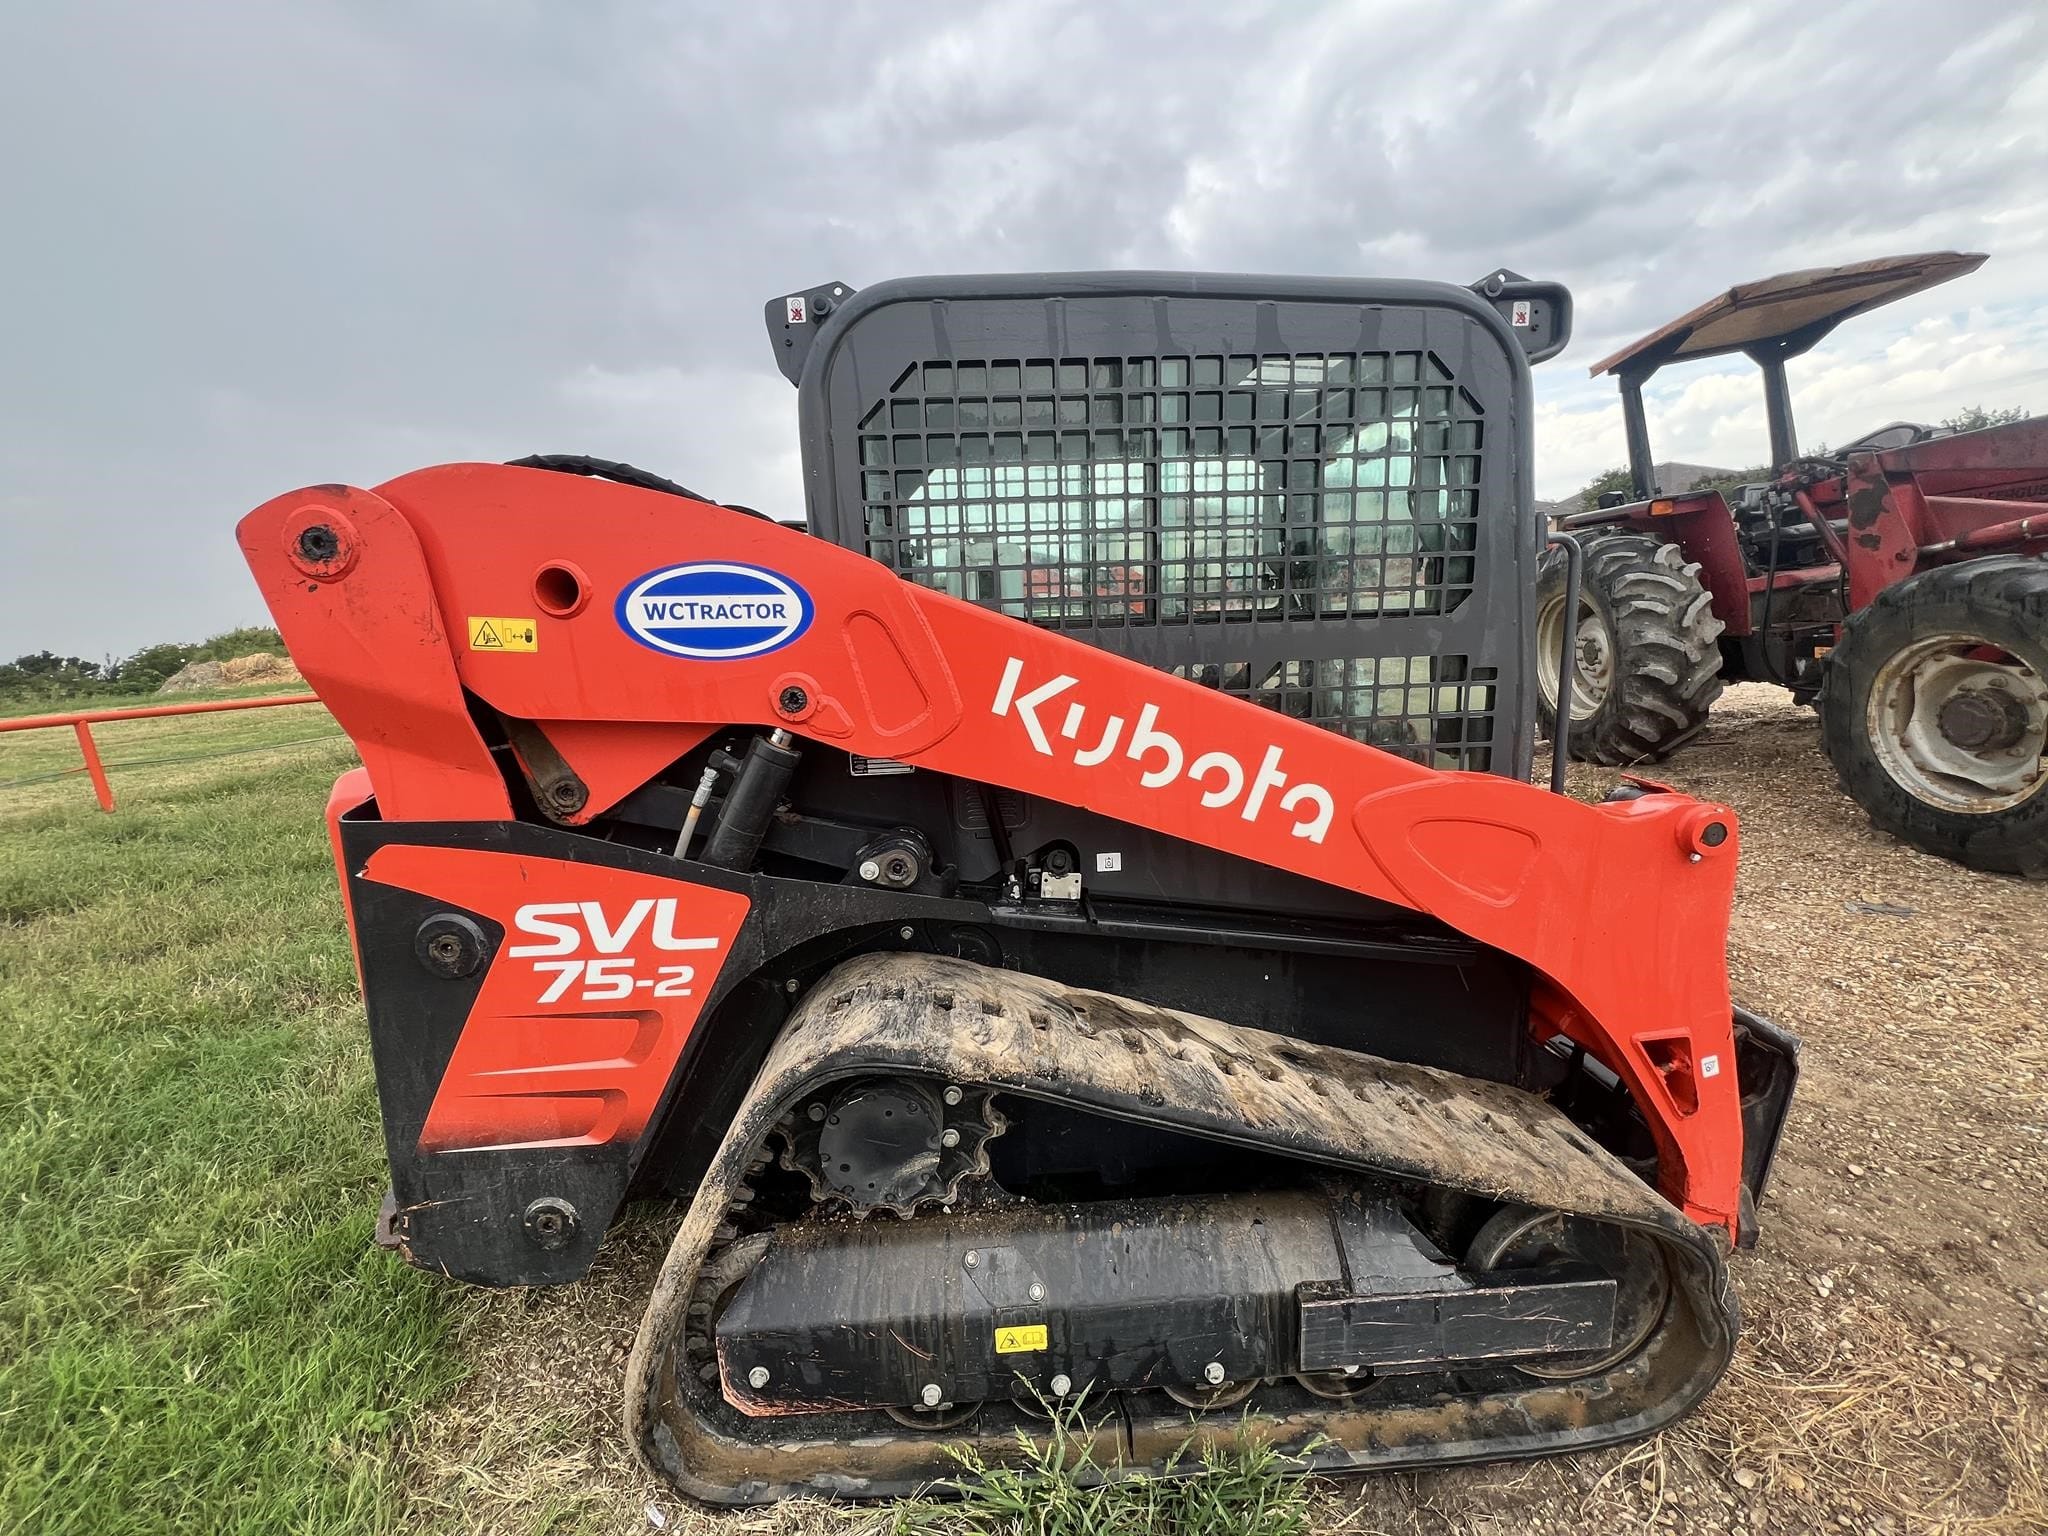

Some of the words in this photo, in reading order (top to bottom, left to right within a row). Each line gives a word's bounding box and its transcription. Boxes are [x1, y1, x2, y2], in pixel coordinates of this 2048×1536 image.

[643, 602, 787, 620] WCTRACTOR
[991, 657, 1335, 844] Kubota
[509, 898, 719, 958] SVL
[533, 958, 695, 1003] 75-2
